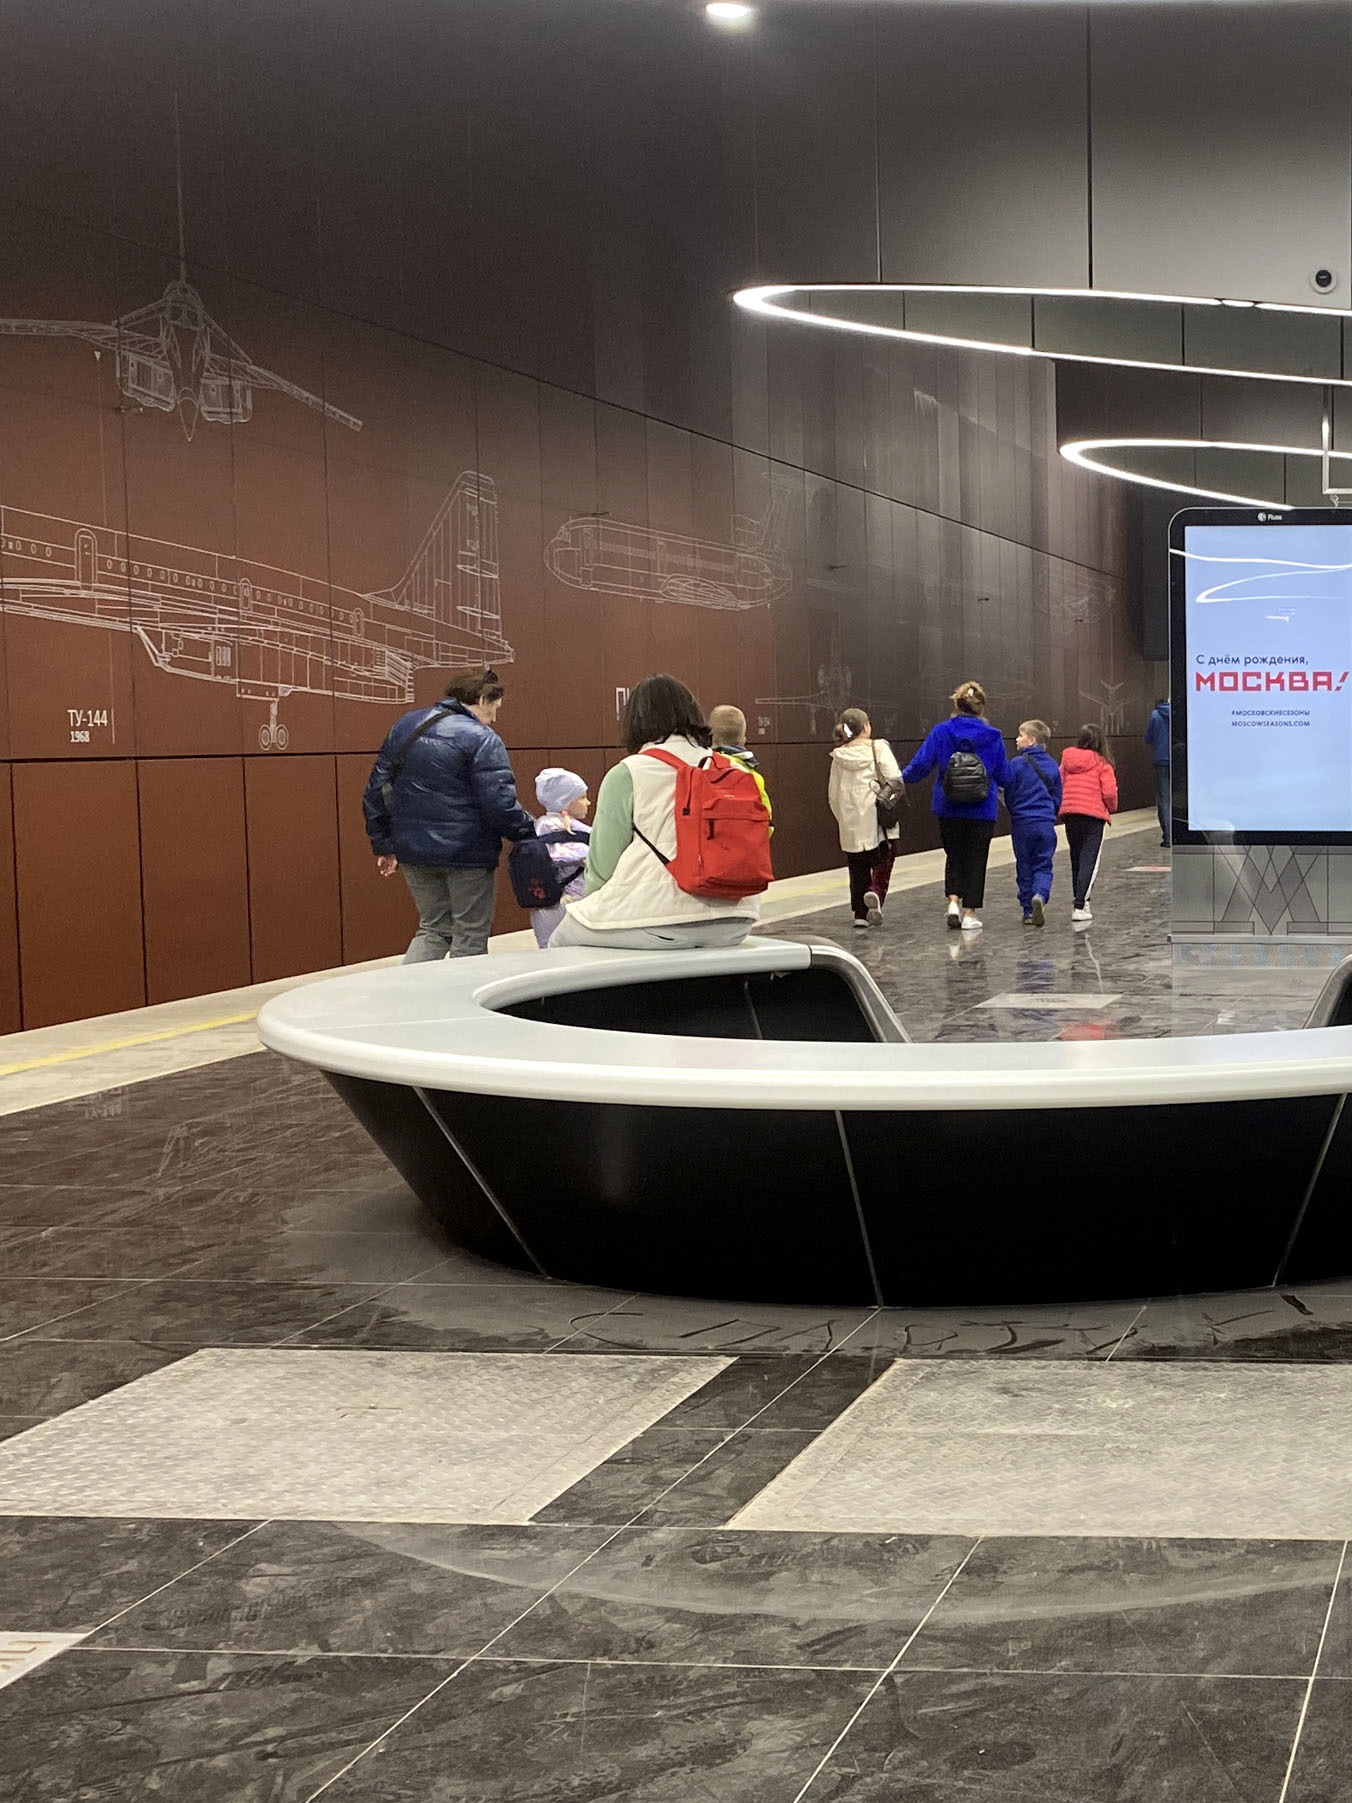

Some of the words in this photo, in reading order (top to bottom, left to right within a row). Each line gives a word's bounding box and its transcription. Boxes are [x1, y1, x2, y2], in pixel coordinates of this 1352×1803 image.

[1196, 654, 1206, 665] С
[1208, 654, 1241, 666] днём
[1244, 655, 1309, 667] рождения,
[1195, 671, 1350, 692] МОСКВА!
[67, 709, 108, 727] ТУ-144
[70, 730, 90, 743] 1968
